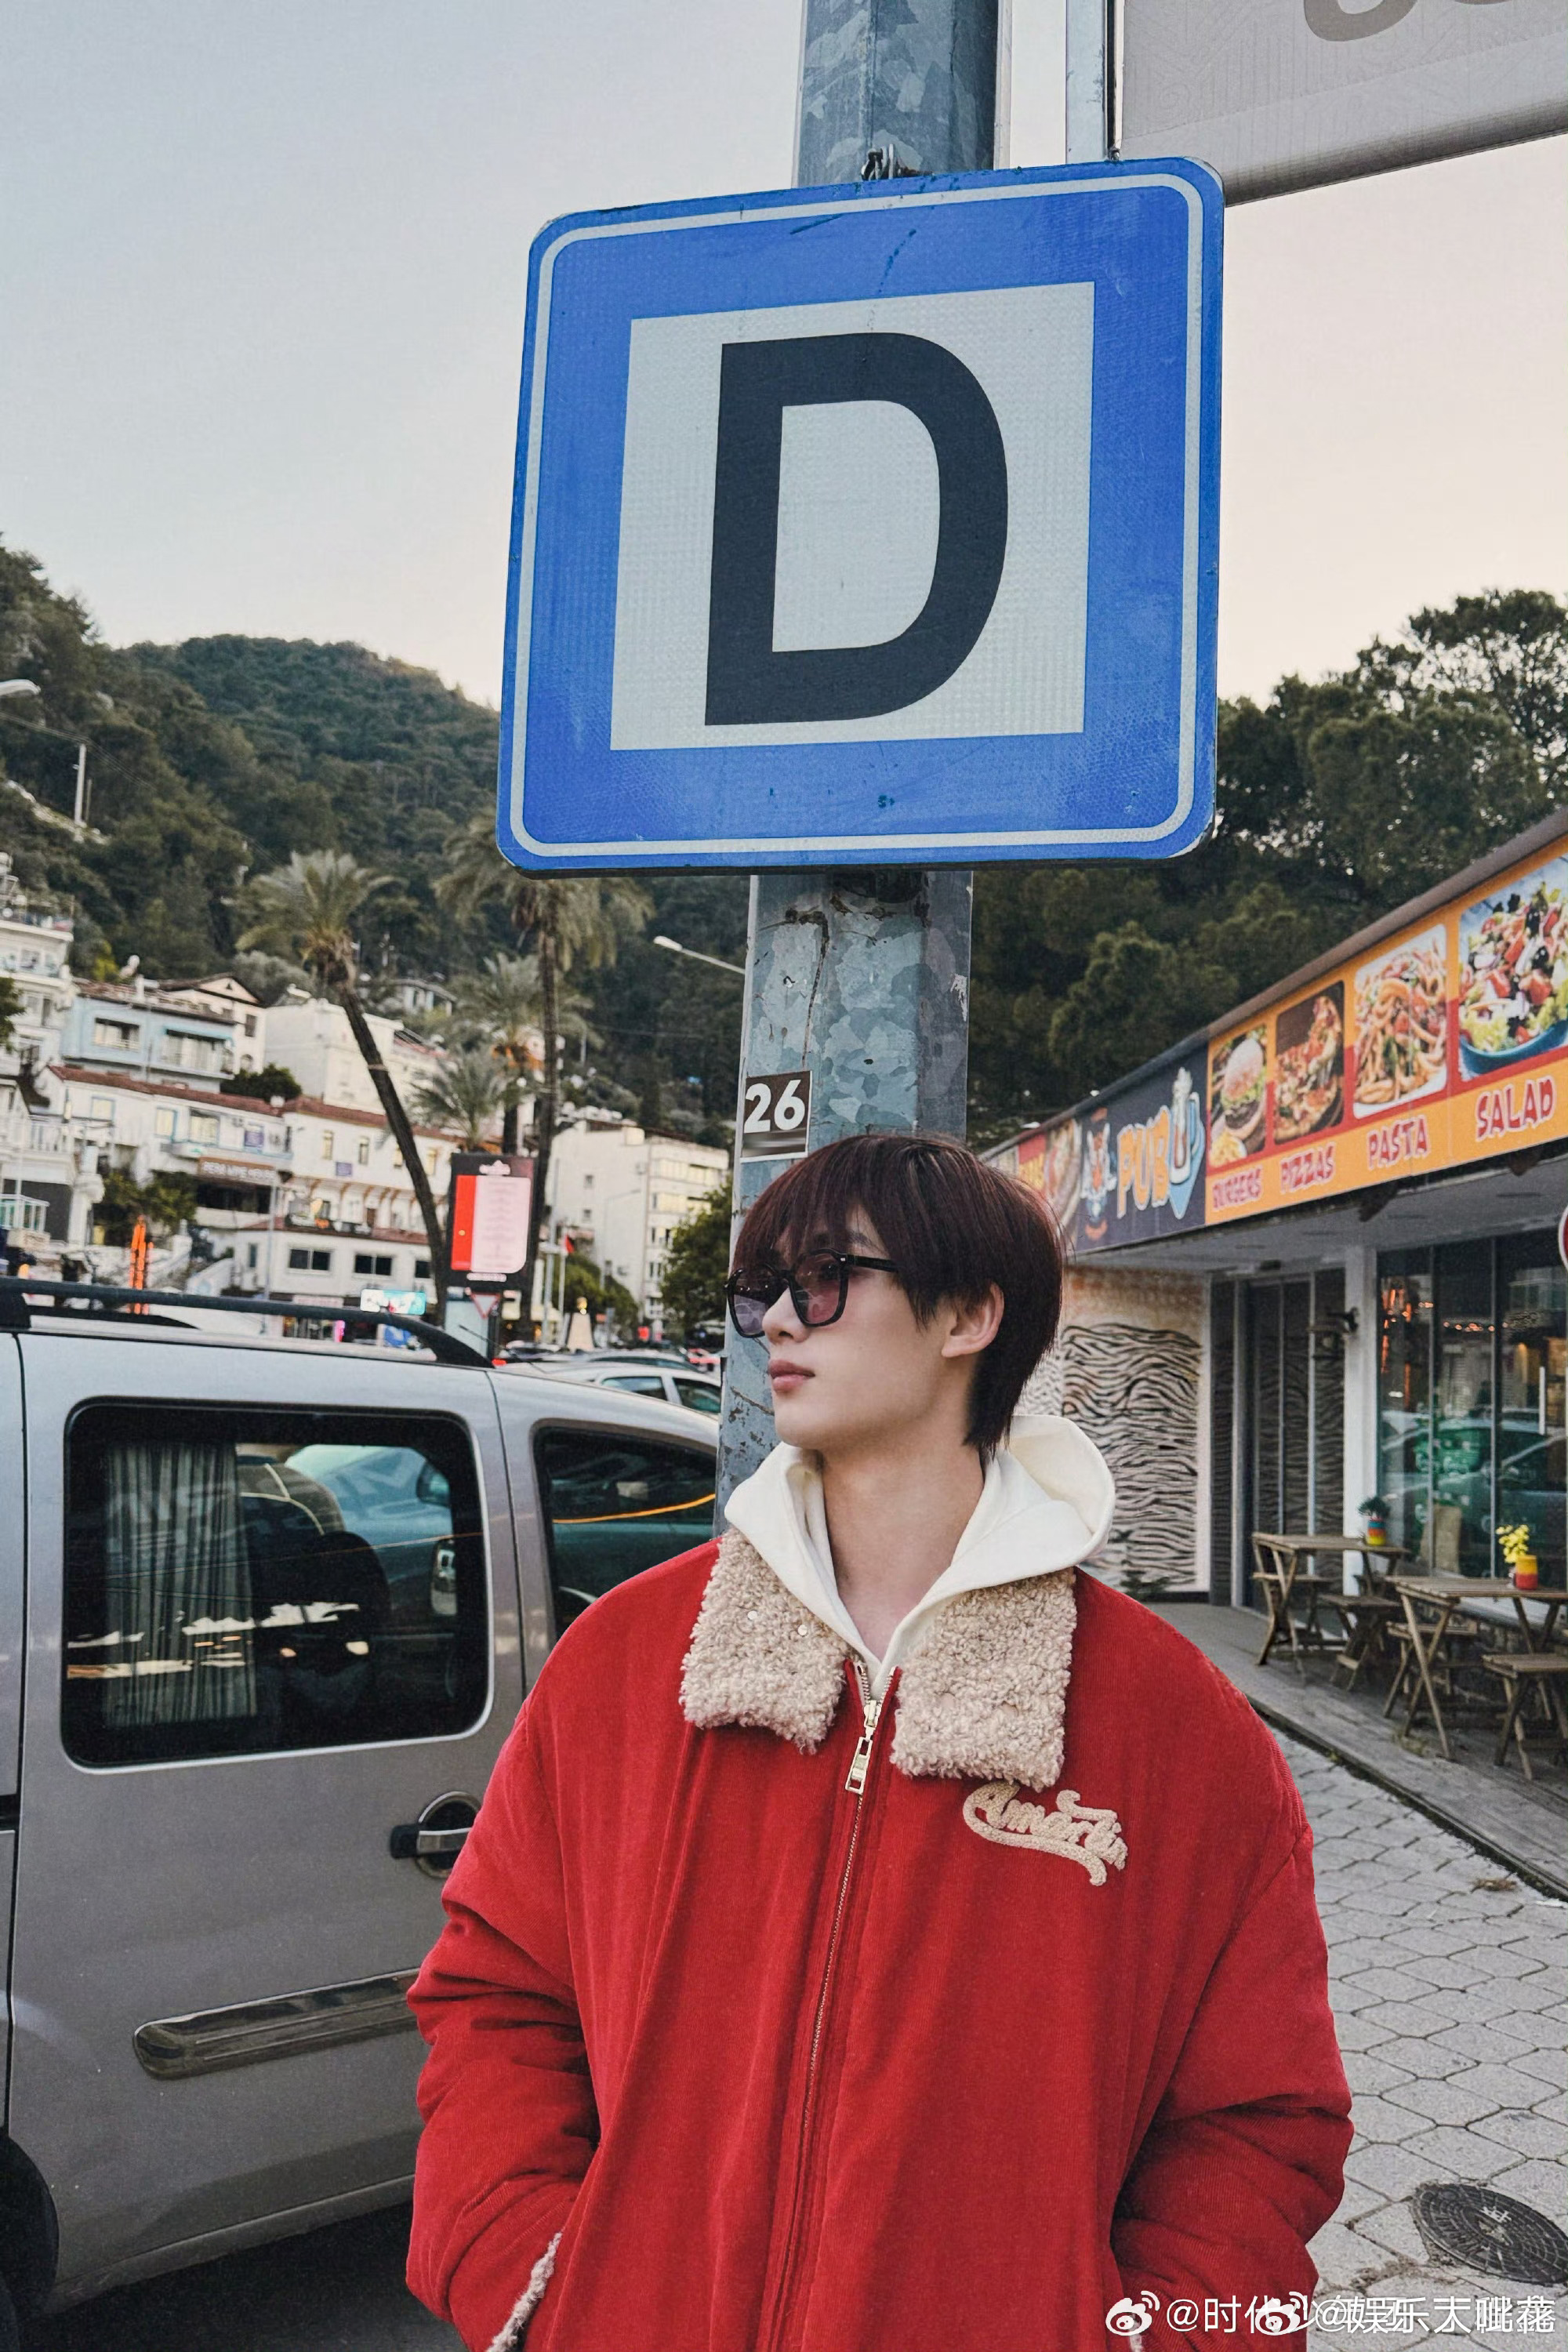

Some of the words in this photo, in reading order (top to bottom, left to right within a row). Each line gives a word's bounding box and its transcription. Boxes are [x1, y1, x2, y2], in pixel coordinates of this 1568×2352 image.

[704, 332, 1009, 726] D
[744, 1079, 805, 1134] 26
[1476, 1076, 1556, 1142] SALAD
[1117, 1105, 1171, 1219] PUB
[1280, 1142, 1336, 1193] PIZZAS
[1367, 1115, 1430, 1170] PASTA
